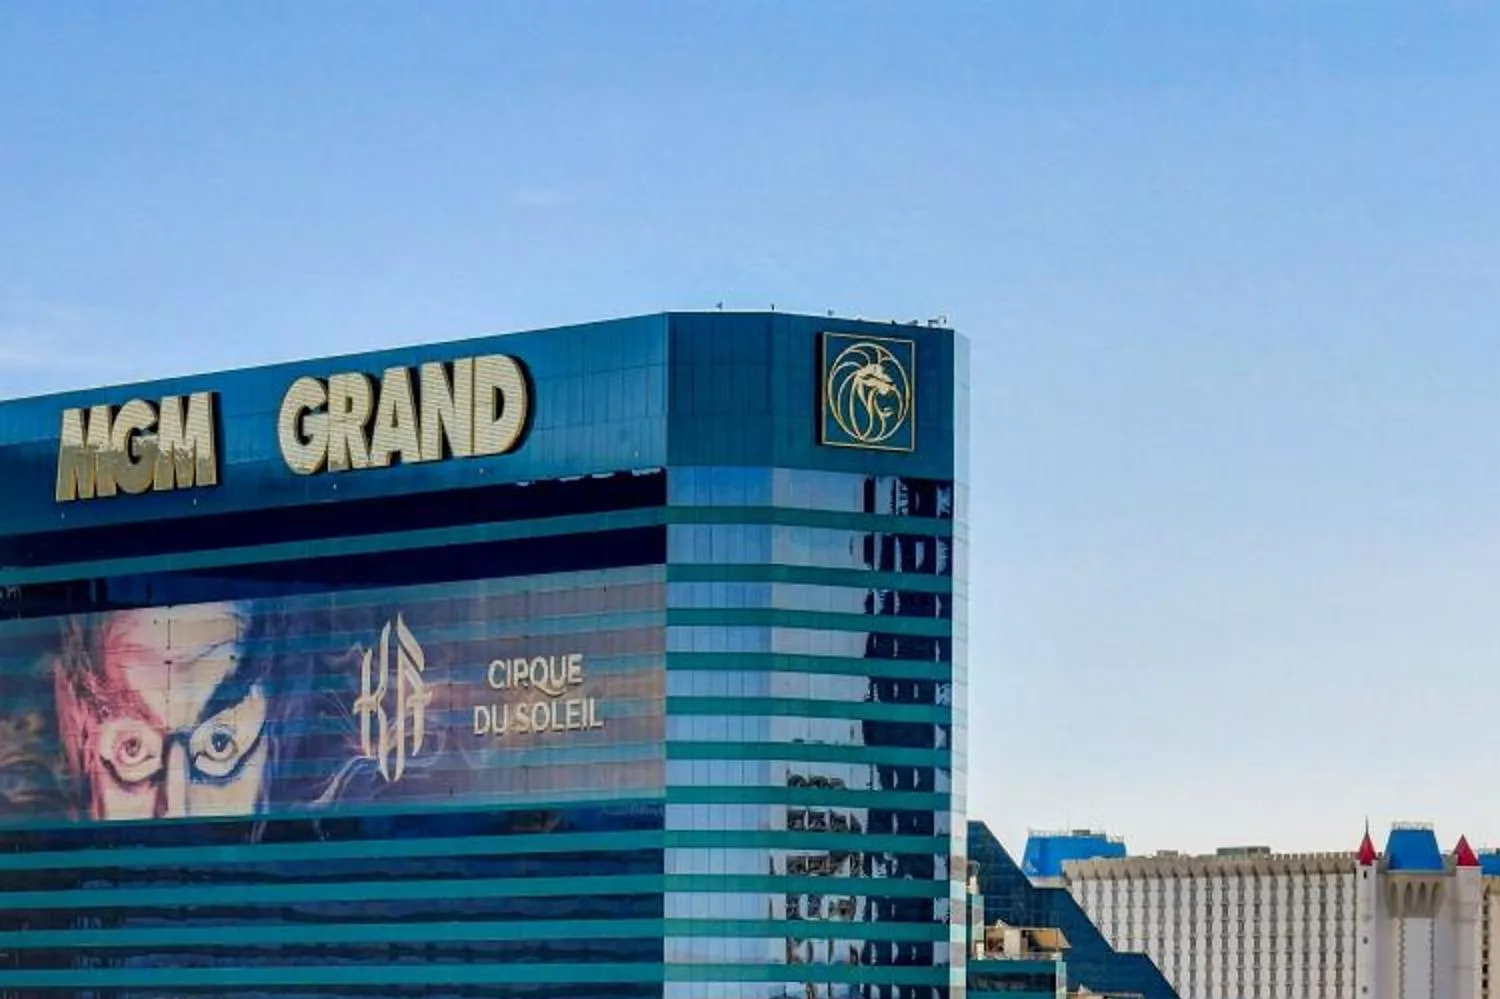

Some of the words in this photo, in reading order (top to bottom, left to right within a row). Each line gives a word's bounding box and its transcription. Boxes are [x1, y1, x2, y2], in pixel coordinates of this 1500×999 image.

[56, 392, 219, 501] MGM
[278, 353, 531, 475] GRAND
[487, 653, 583, 697] CIRQUE
[473, 704, 508, 735] DU
[510, 698, 604, 733] SOLEIL
